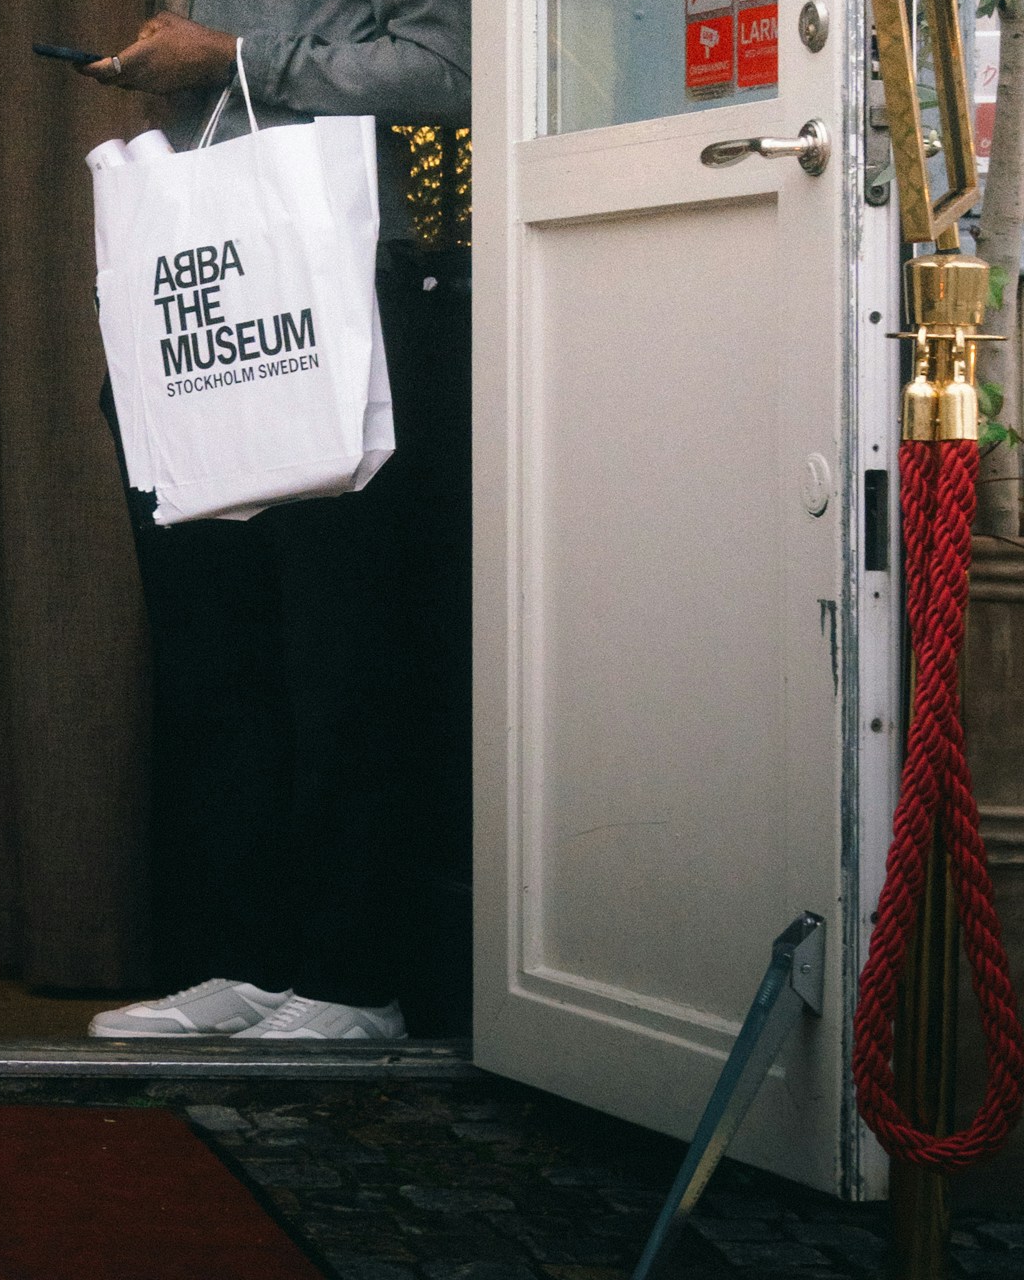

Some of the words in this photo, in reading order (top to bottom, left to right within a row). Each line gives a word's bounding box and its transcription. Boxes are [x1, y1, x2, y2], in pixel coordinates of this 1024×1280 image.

[153, 239, 245, 296] ABBA
[154, 285, 225, 335] THE
[160, 308, 316, 377] MUSEUM
[166, 366, 255, 397] STOCKHOLM
[259, 353, 320, 379] SWEDEN
